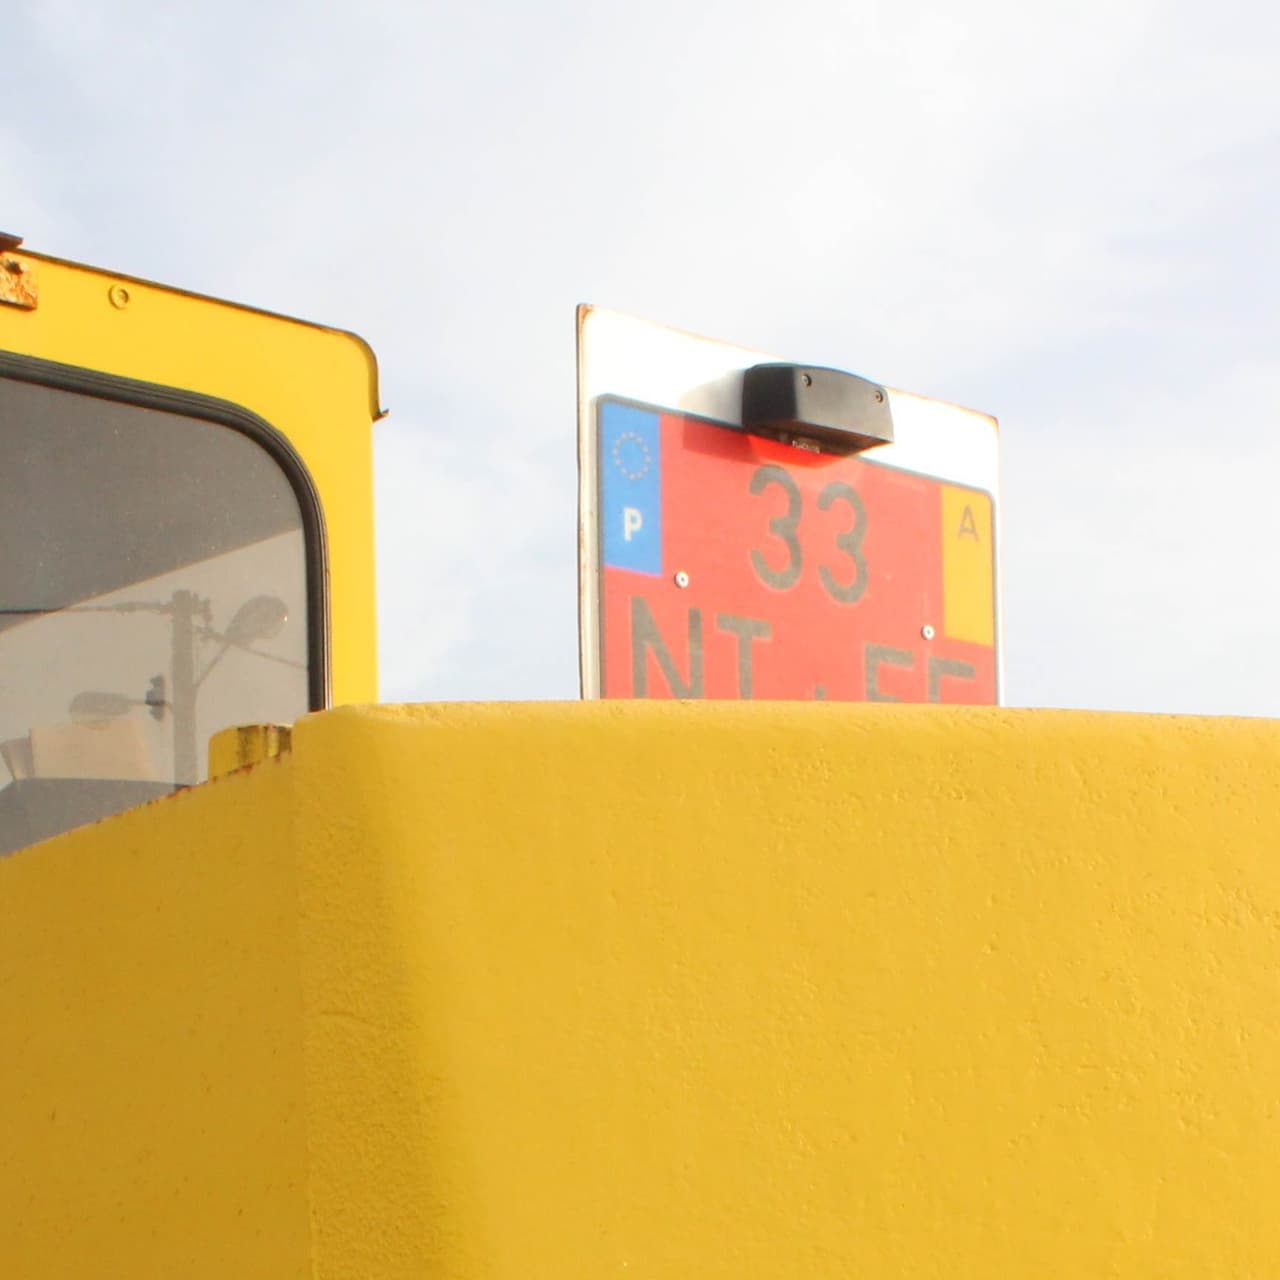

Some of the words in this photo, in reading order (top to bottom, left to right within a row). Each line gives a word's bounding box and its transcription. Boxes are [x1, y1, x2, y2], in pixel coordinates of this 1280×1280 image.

[624, 507, 643, 542] P
[749, 464, 870, 605] 33
[957, 505, 980, 544] A
[630, 595, 773, 701] NT
